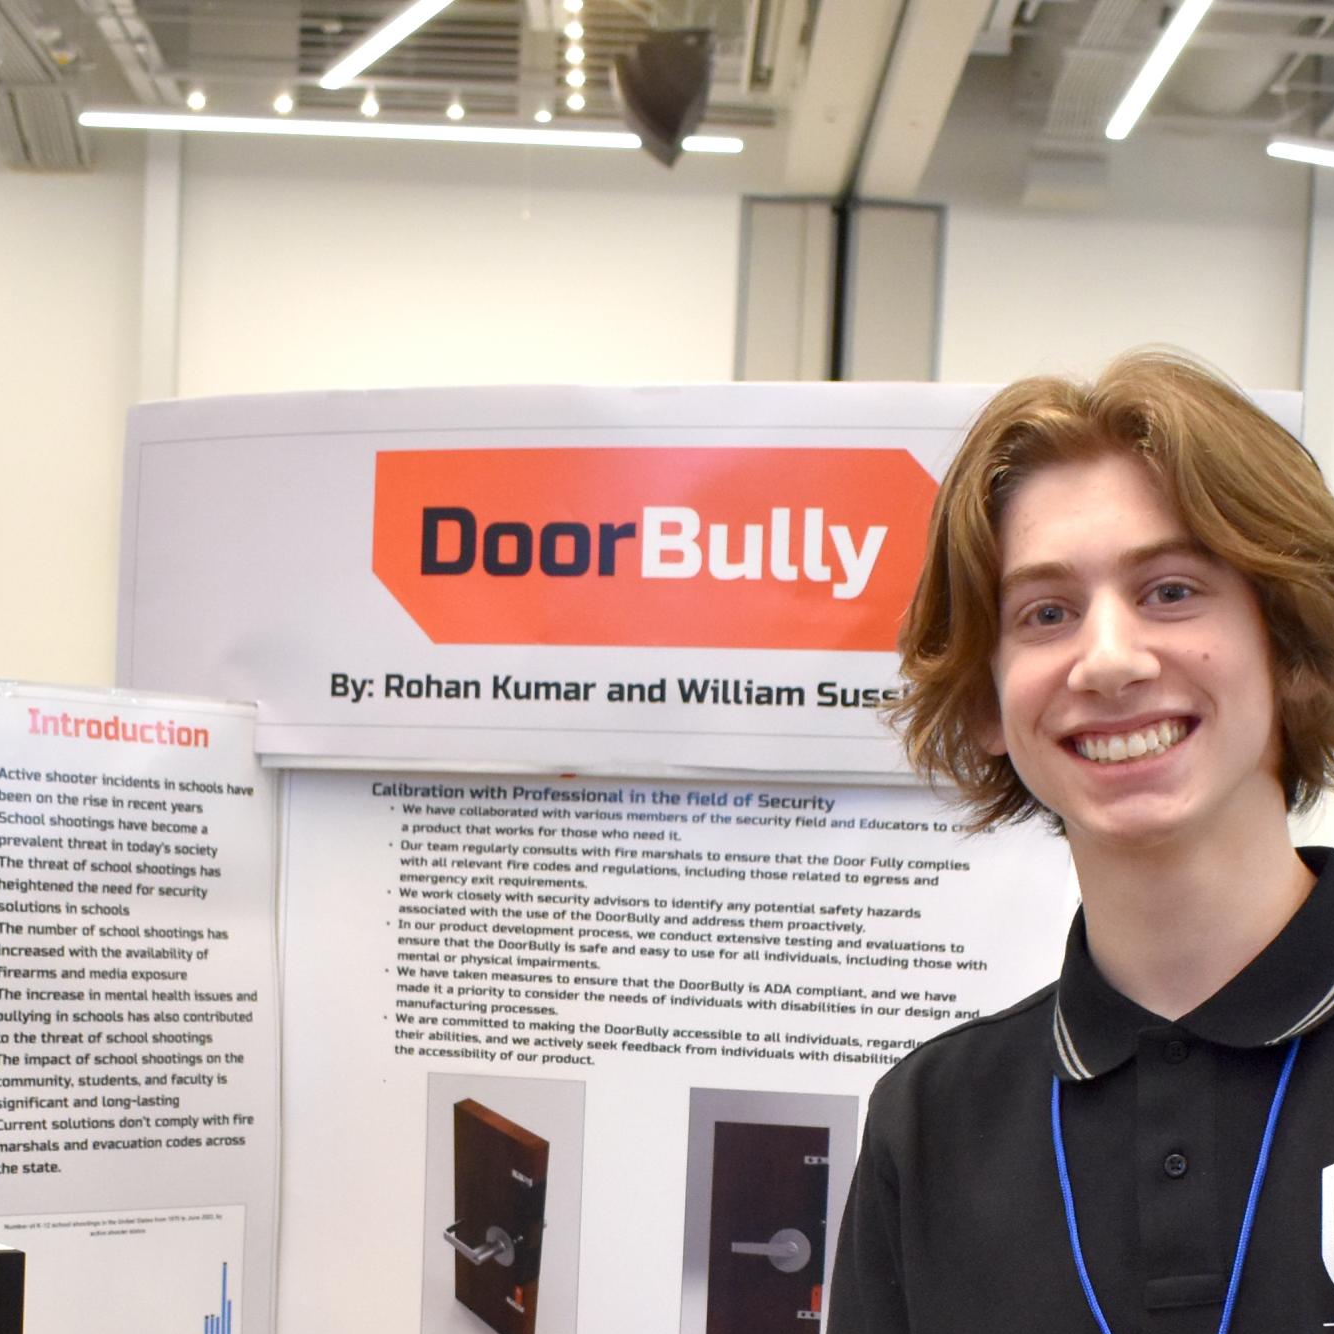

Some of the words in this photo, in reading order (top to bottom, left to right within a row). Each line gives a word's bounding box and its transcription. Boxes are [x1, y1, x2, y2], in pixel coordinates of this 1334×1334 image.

[421, 506, 887, 599] DoorBully
[331, 673, 374, 703] By:
[385, 673, 481, 699] Rohan
[492, 675, 596, 701] Kumar
[607, 678, 666, 703] and
[677, 678, 805, 706] William
[29, 707, 211, 749] Introduction
[45, 770, 98, 785] shooter
[102, 774, 161, 789] incidents
[164, 778, 175, 790] in
[178, 780, 224, 794] schools
[226, 783, 254, 796] have
[371, 782, 465, 801] Calibration
[469, 785, 509, 801] with
[512, 787, 624, 805] Professional
[628, 788, 647, 805] in
[651, 790, 681, 806] the
[687, 790, 729, 807] field
[733, 792, 754, 808] of
[758, 793, 837, 814] Security
[49, 814, 115, 832] shootings
[118, 818, 148, 831] have
[151, 820, 198, 834] become
[201, 825, 208, 835] a
[67, 837, 107, 851] threat
[111, 839, 123, 851] in
[126, 841, 171, 856] today's
[174, 844, 218, 859] society
